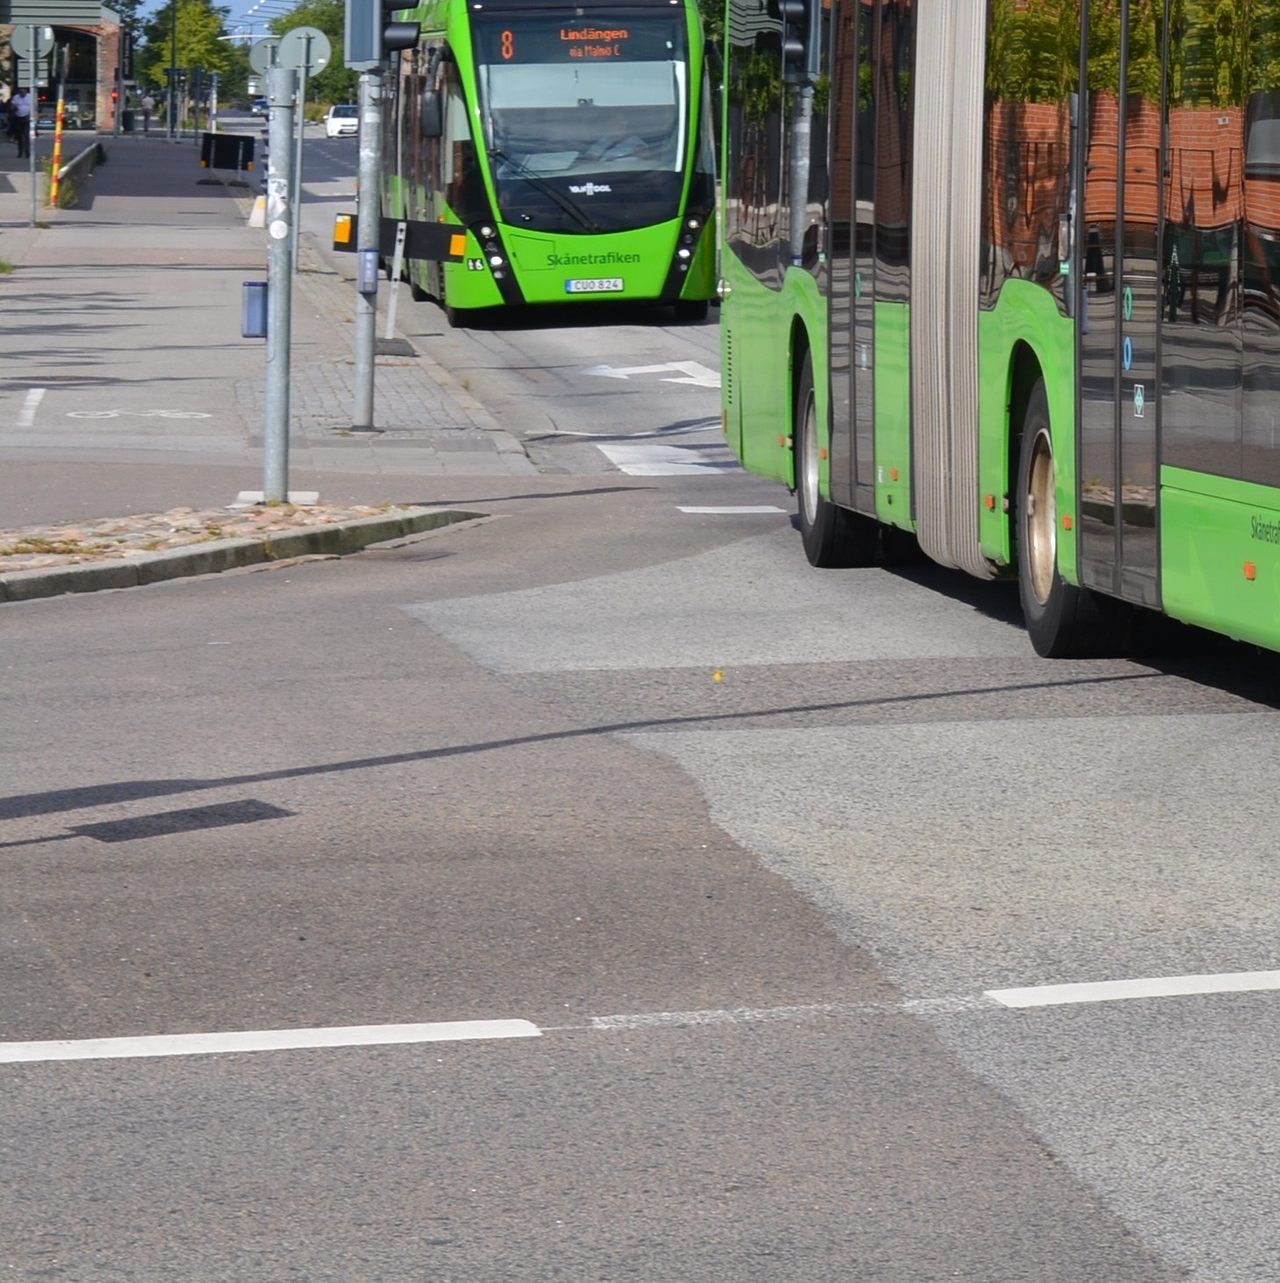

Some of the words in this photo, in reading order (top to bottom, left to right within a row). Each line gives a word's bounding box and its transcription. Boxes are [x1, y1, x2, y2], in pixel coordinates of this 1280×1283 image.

[560, 28, 629, 42] Lindängen
[501, 30, 514, 59] 8
[547, 251, 641, 266] Skånetrafiken
